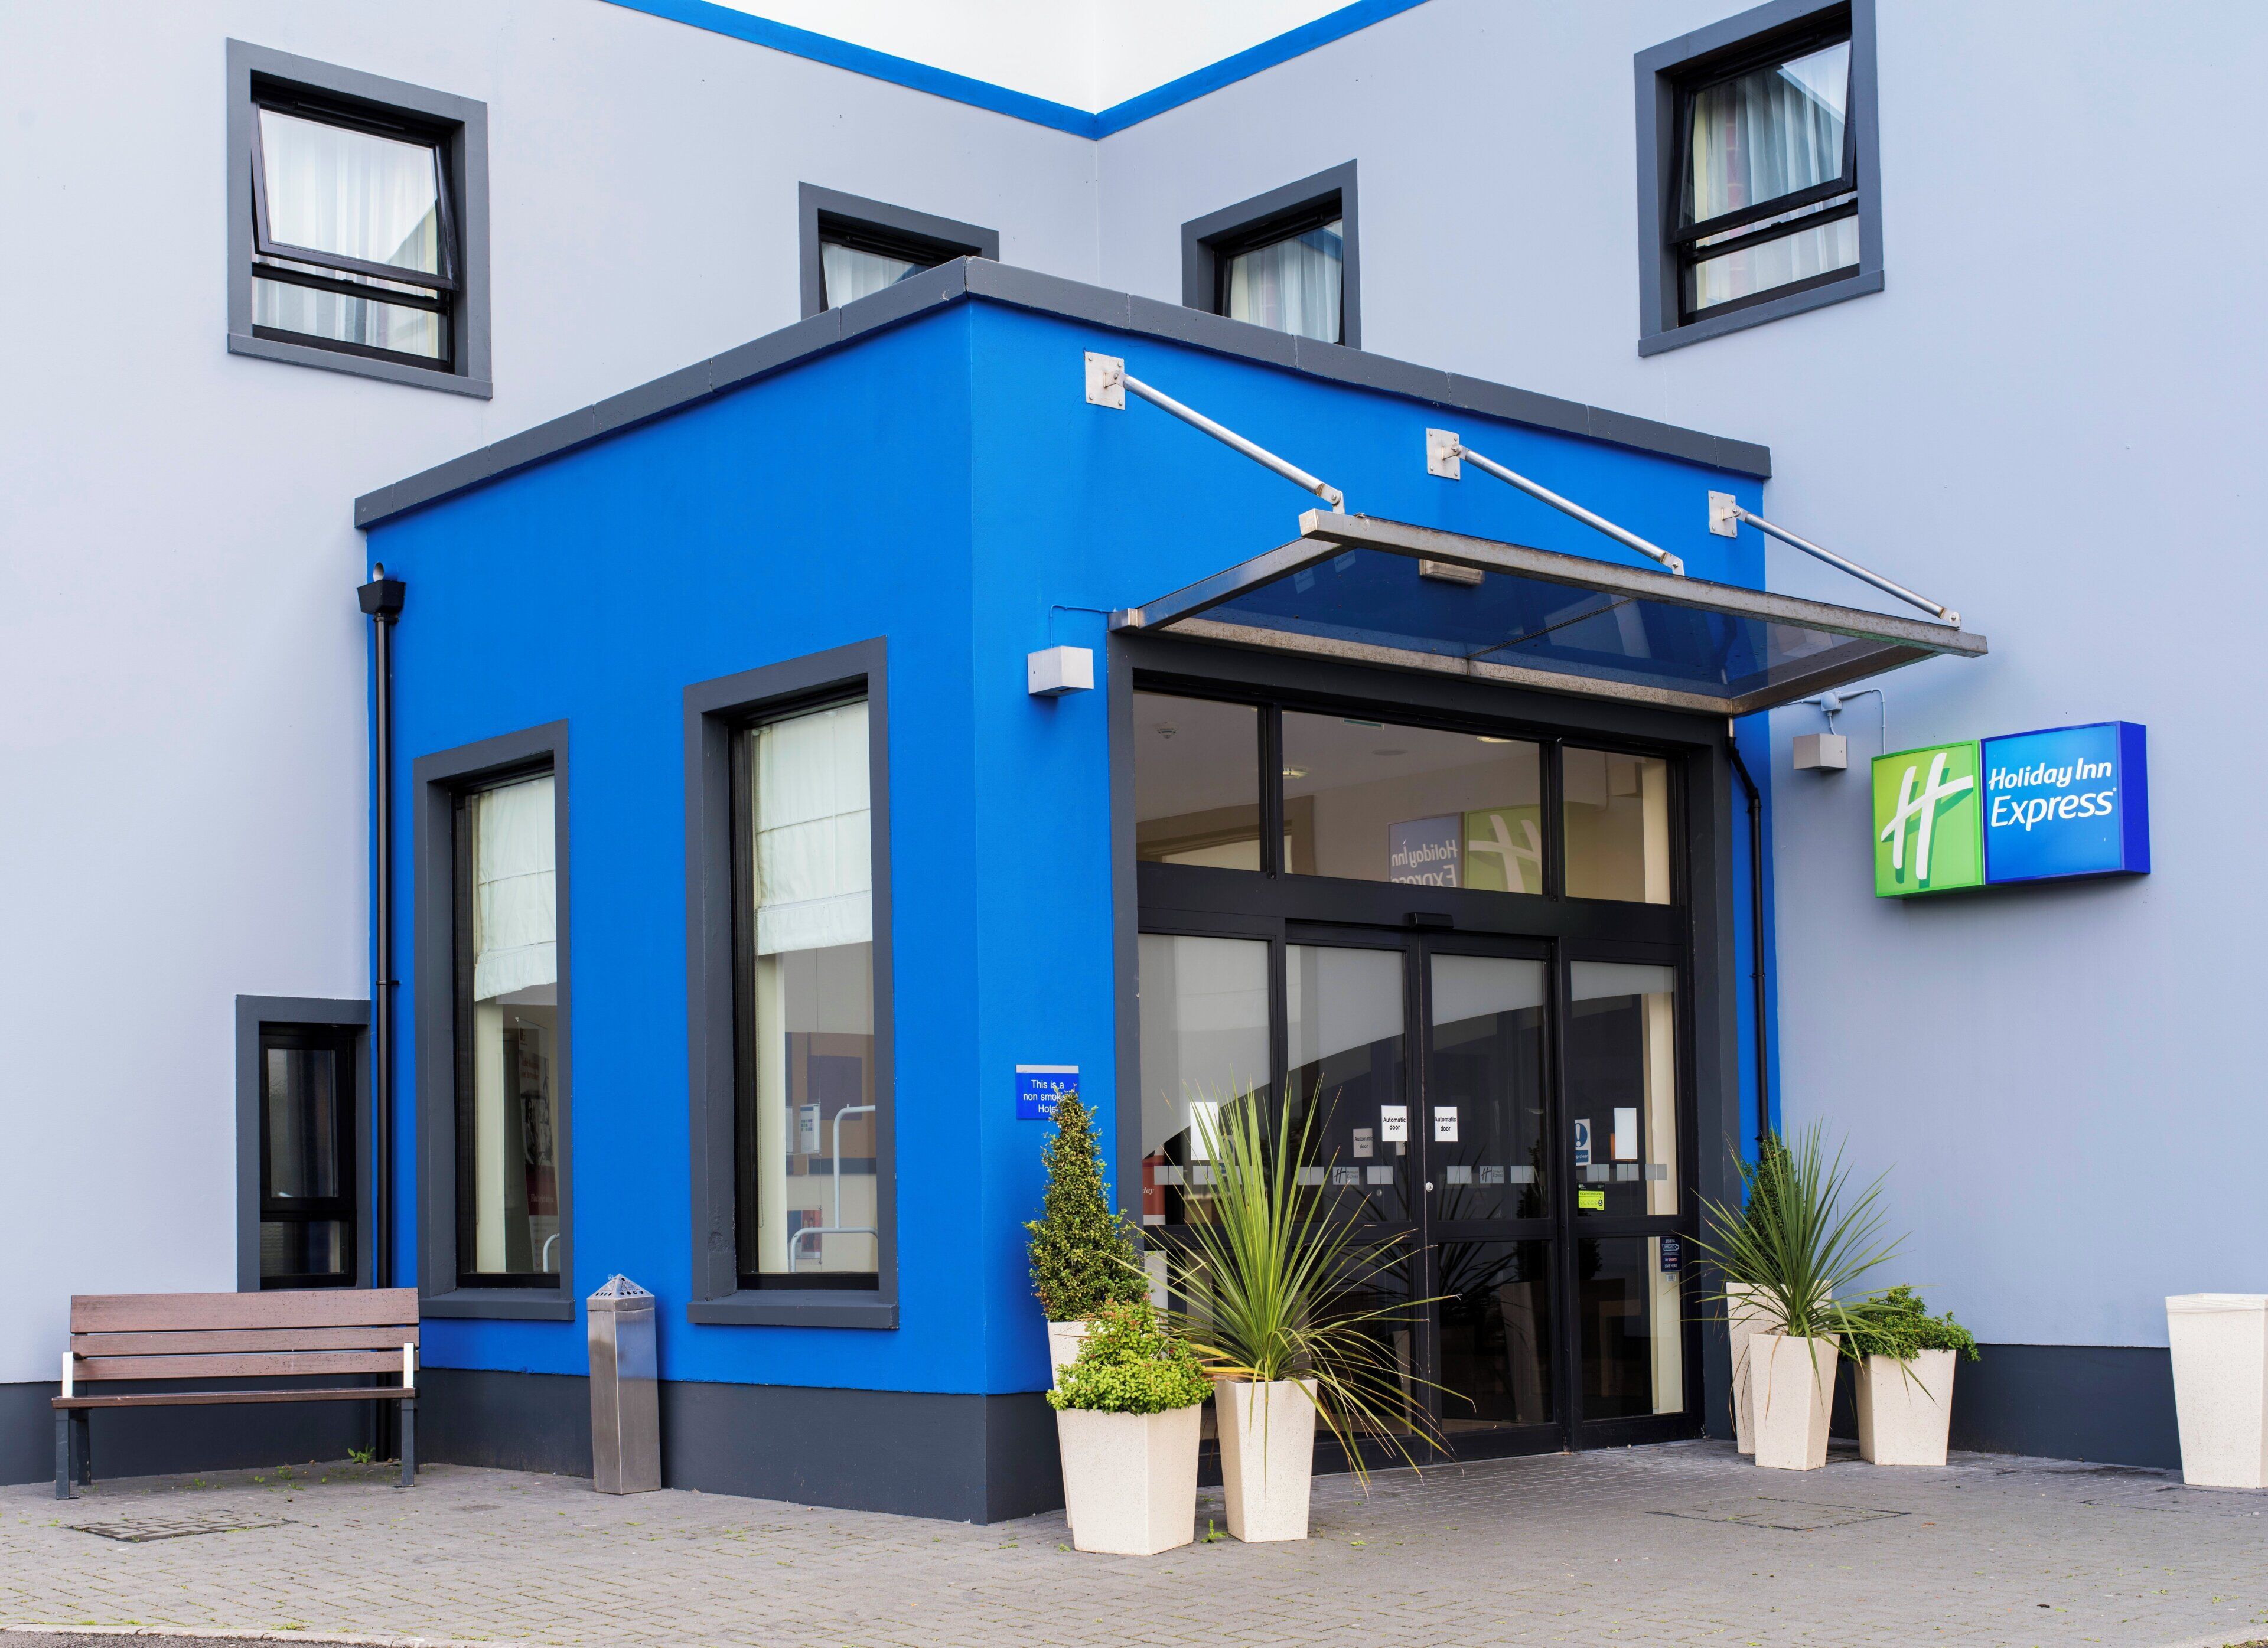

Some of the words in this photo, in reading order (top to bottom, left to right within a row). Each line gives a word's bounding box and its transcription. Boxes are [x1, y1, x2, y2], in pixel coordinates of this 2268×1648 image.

[1988, 763, 2073, 791] Holiday
[2075, 758, 2112, 780] Inn
[1031, 1079, 1047, 1089] This
[1051, 1080, 1056, 1089] is
[1038, 1104, 1057, 1113] Hote
